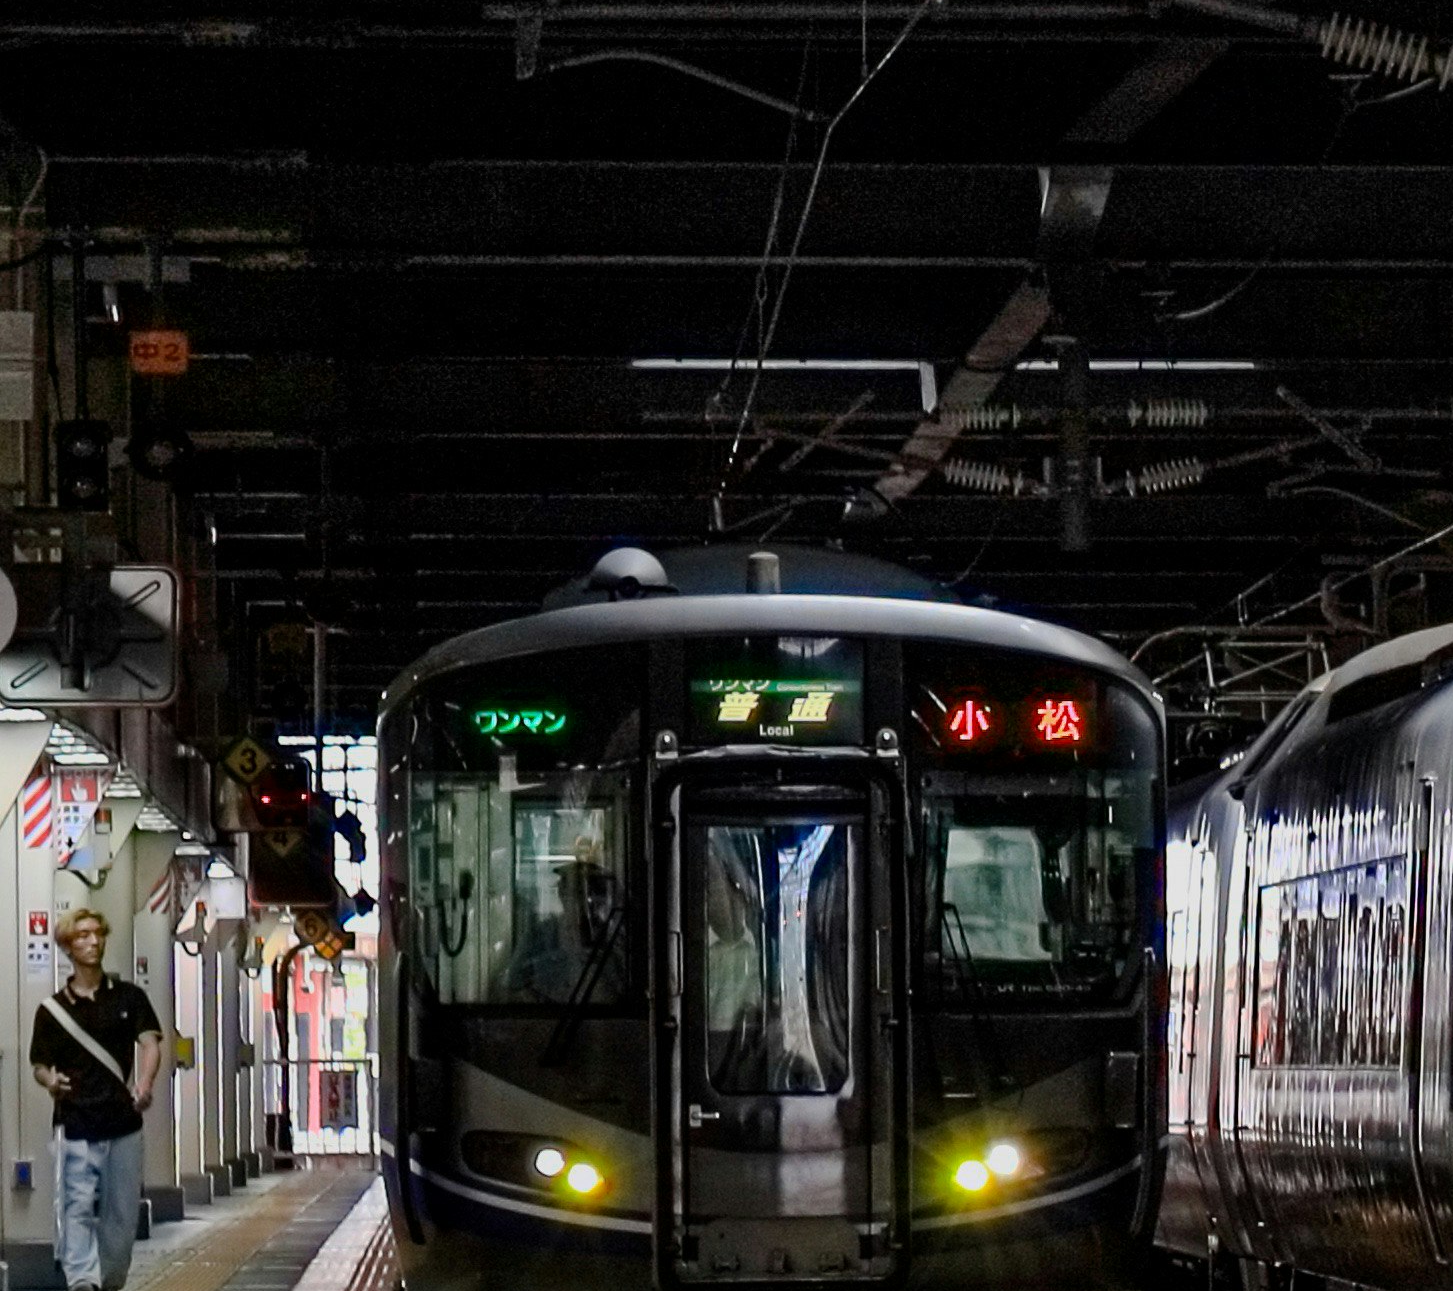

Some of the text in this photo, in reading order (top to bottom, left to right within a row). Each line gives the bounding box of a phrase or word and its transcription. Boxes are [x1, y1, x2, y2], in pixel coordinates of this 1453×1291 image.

[475, 710, 567, 734] ワンマン
[759, 724, 794, 737] Local
[949, 700, 1080, 741] 小松
[240, 748, 258, 776] 3
